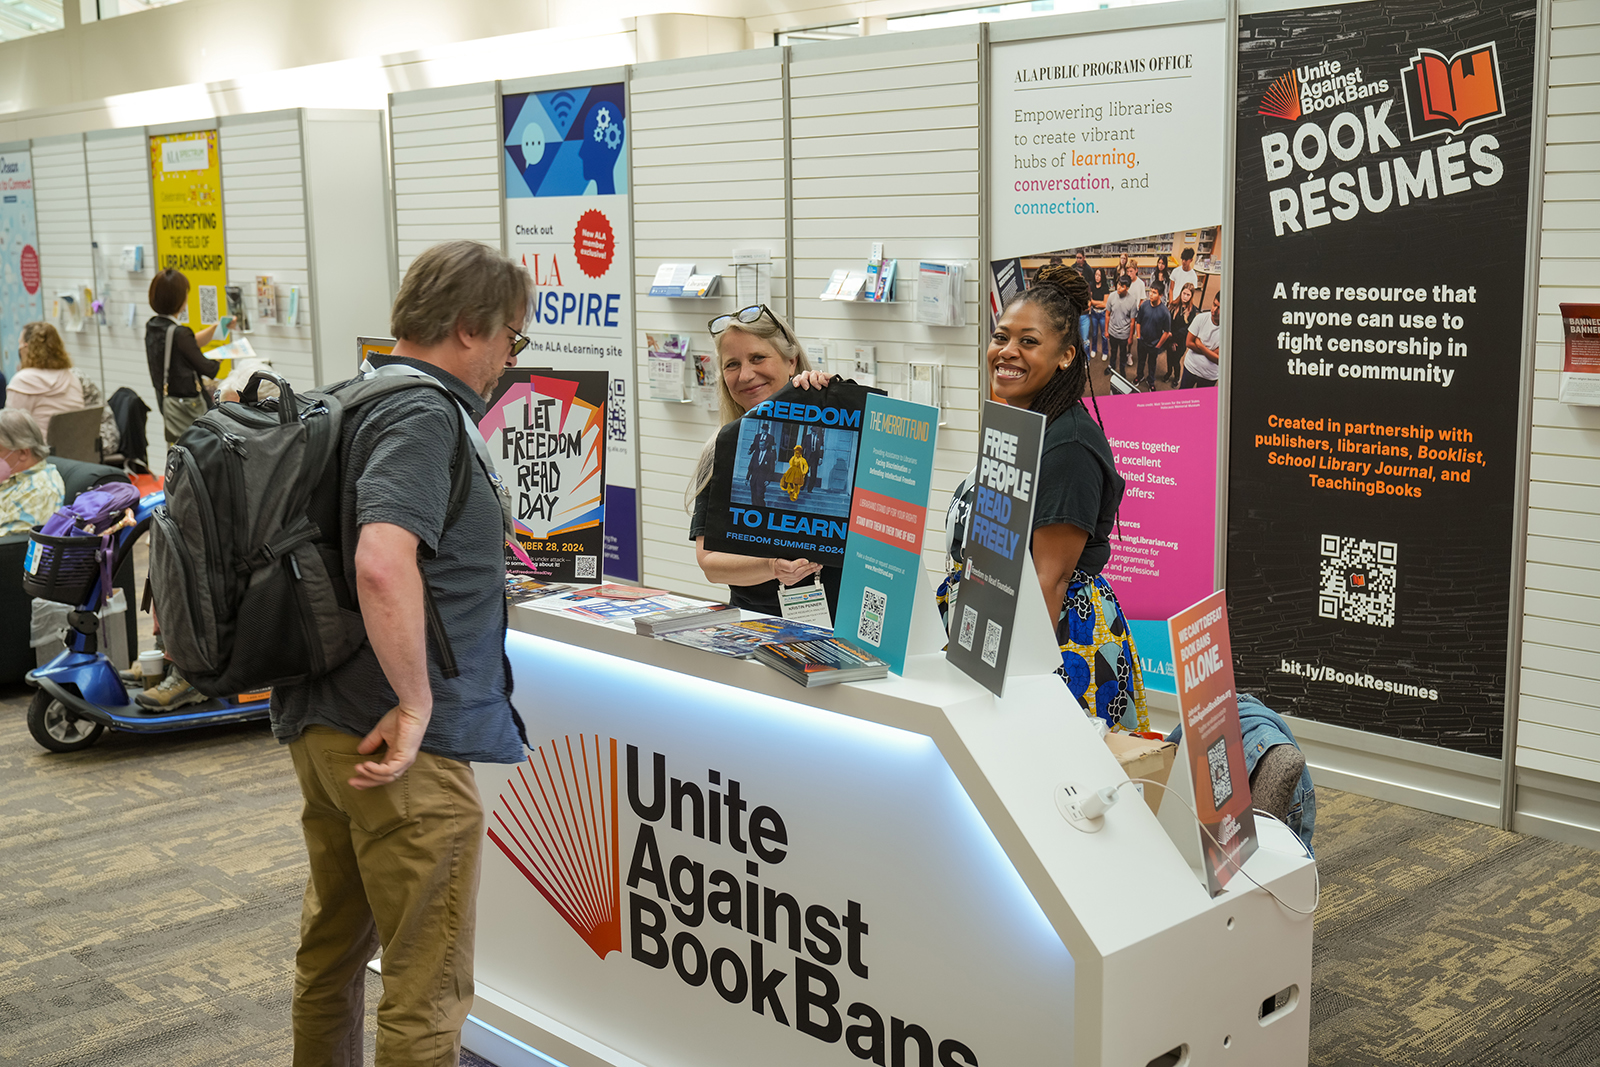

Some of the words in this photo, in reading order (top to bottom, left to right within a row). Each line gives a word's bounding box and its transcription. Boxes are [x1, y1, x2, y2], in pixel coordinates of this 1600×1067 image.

[1082, 58, 1146, 78] PROGRAMS
[1149, 54, 1193, 71] OFFICE
[1297, 60, 1341, 83] Unite
[1301, 67, 1363, 99] Against
[1014, 104, 1103, 125] Empowering
[1109, 99, 1173, 117] libraries
[1014, 134, 1028, 146] to
[1033, 130, 1076, 145] create
[1081, 127, 1135, 142] vibrant
[1261, 99, 1401, 182] BOOK
[1014, 154, 1047, 169] hubs
[1051, 152, 1067, 168] of
[1071, 147, 1140, 169] learning,
[1014, 173, 1115, 192] conversation,
[1120, 173, 1149, 189] and
[1269, 133, 1504, 237] RÉSUMÉS
[1014, 197, 1099, 215] connection.
[162, 213, 217, 230] DIVERSIFYING
[515, 225, 539, 235] Check
[540, 225, 553, 235] out
[170, 236, 181, 248] THE
[182, 236, 199, 248] FIELD
[582, 228, 595, 238] New
[594, 231, 607, 241] ALA
[582, 239, 605, 250] member
[161, 255, 222, 271] LIBRARIANSHIP
[580, 248, 607, 259] exclusive!
[1273, 282, 1287, 299] A
[1292, 281, 1331, 300] free
[1335, 286, 1427, 302] resource
[1432, 284, 1477, 303] that
[534, 291, 621, 328] NSPIRE
[1282, 310, 1352, 329] anyone
[1357, 313, 1394, 328] can
[1399, 314, 1437, 329] use
[1442, 312, 1464, 330] to
[531, 341, 544, 352] the
[545, 341, 561, 353] ALA
[564, 343, 604, 358] eLearning
[606, 346, 623, 357] site
[1277, 332, 1323, 354] fight
[1327, 336, 1442, 360] censorship
[1447, 337, 1468, 357] in
[1287, 358, 1334, 377] their
[1338, 363, 1455, 388] community
[523, 398, 556, 432] LET
[870, 410, 882, 431] THE
[881, 413, 911, 438] MERRITT
[910, 419, 929, 442] FUND
[1267, 414, 1324, 431] Created
[1327, 418, 1341, 432] in
[1344, 422, 1434, 442] partnership
[1438, 427, 1473, 443] with
[502, 426, 581, 465] FREEDOM
[983, 427, 1018, 464] FREE
[1108, 437, 1139, 449] diences
[1141, 441, 1180, 454] together
[1255, 433, 1333, 453] publishers,
[1337, 438, 1413, 461] librarians,
[1418, 445, 1487, 467] Booklist,
[1122, 456, 1161, 468] excellent
[1267, 451, 1316, 469] School
[1319, 456, 1371, 476] Library
[1374, 461, 1437, 482] Journal,
[1440, 469, 1471, 483] and
[518, 461, 560, 493] READ
[979, 456, 1032, 502] PEOPLE
[1147, 473, 1177, 486] States.
[1309, 474, 1422, 498] TeachingBooks
[975, 485, 1012, 525] READ
[1126, 487, 1155, 499] offers:
[518, 491, 559, 522] DAY
[729, 507, 762, 528] TO
[767, 512, 848, 540] LEARN
[545, 542, 559, 552] 28,
[562, 543, 584, 552] 2024
[726, 531, 771, 545] FREEDOM
[773, 538, 817, 551] SUMMER
[818, 544, 845, 555] 2024
[971, 514, 1020, 560] FREELY
[1114, 554, 1154, 568] programming
[1123, 545, 1149, 555] resource
[1150, 548, 1160, 557] for
[971, 565, 985, 580] Freedom
[989, 574, 997, 587] Read
[1101, 572, 1132, 583] velopment
[1110, 563, 1122, 571] and
[1123, 564, 1160, 577] professional
[1178, 627, 1188, 644] WE
[1203, 606, 1222, 629] DEFEAT
[1180, 641, 1197, 662] BOOK
[1195, 632, 1211, 652] BANS
[1140, 657, 1166, 675] ALA
[1184, 644, 1224, 694] ALONE.
[1281, 659, 1439, 701] bit.ly/BookResumes
[626, 743, 788, 865] Unite
[626, 822, 869, 980] Against
